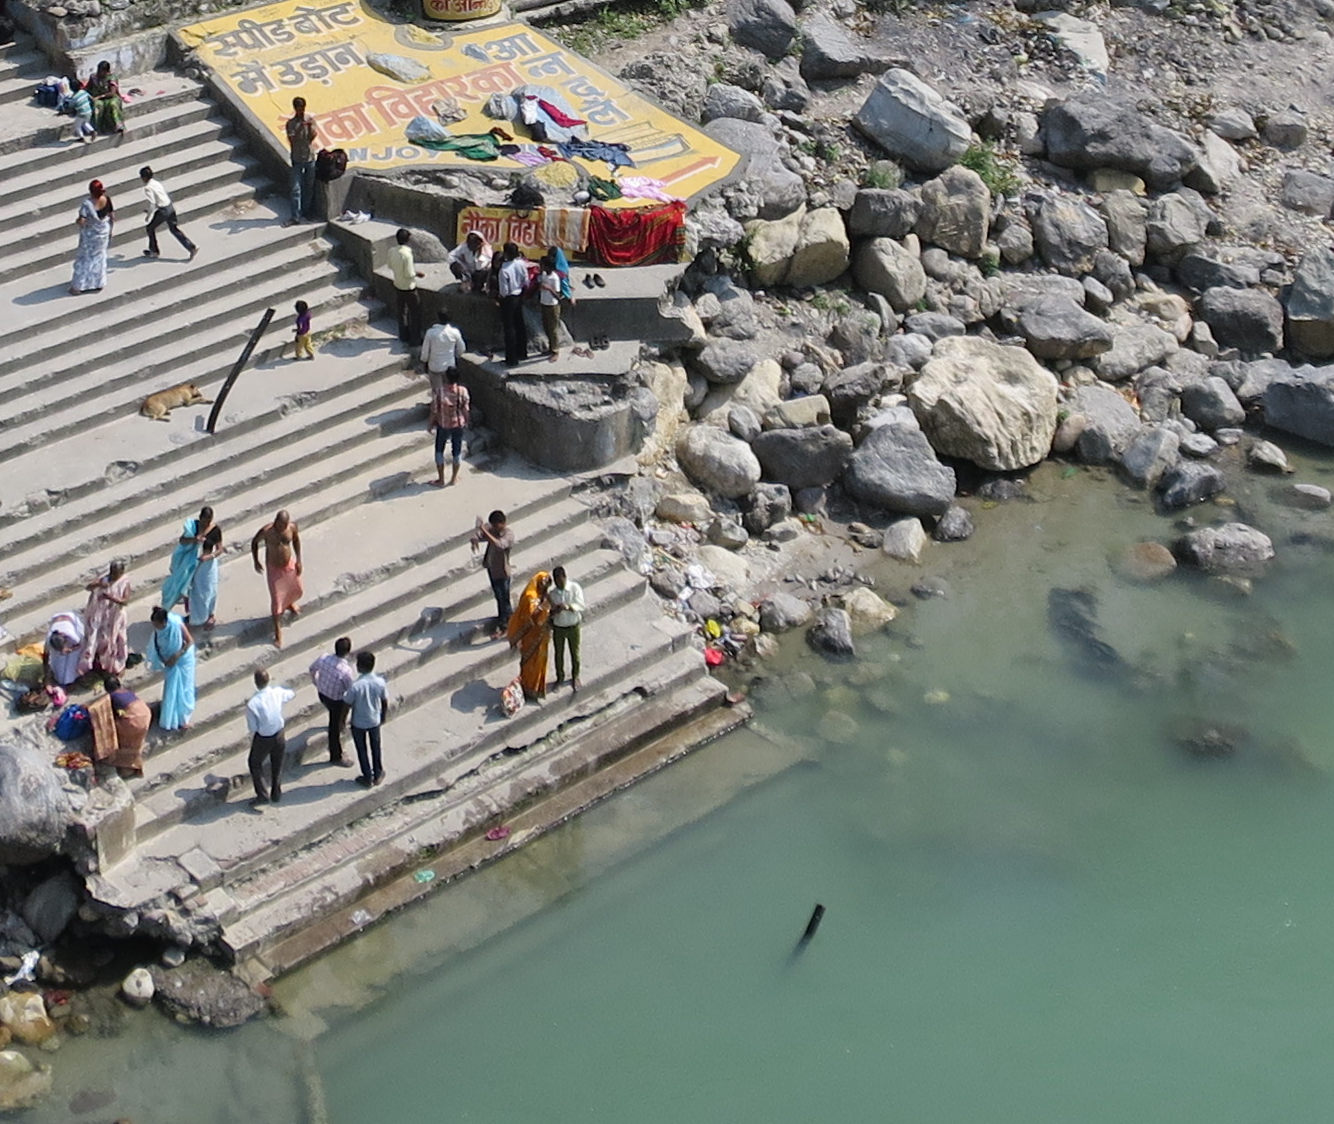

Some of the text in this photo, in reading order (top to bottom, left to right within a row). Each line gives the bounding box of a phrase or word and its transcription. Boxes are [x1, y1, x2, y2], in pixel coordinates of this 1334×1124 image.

[207, 1, 363, 58] स्पीड बोट
[230, 42, 367, 95] में उड़ान
[364, 75, 482, 128] विहार
[466, 61, 528, 94] का
[348, 144, 442, 163] NJOY
[461, 209, 541, 247] नौका विहा
